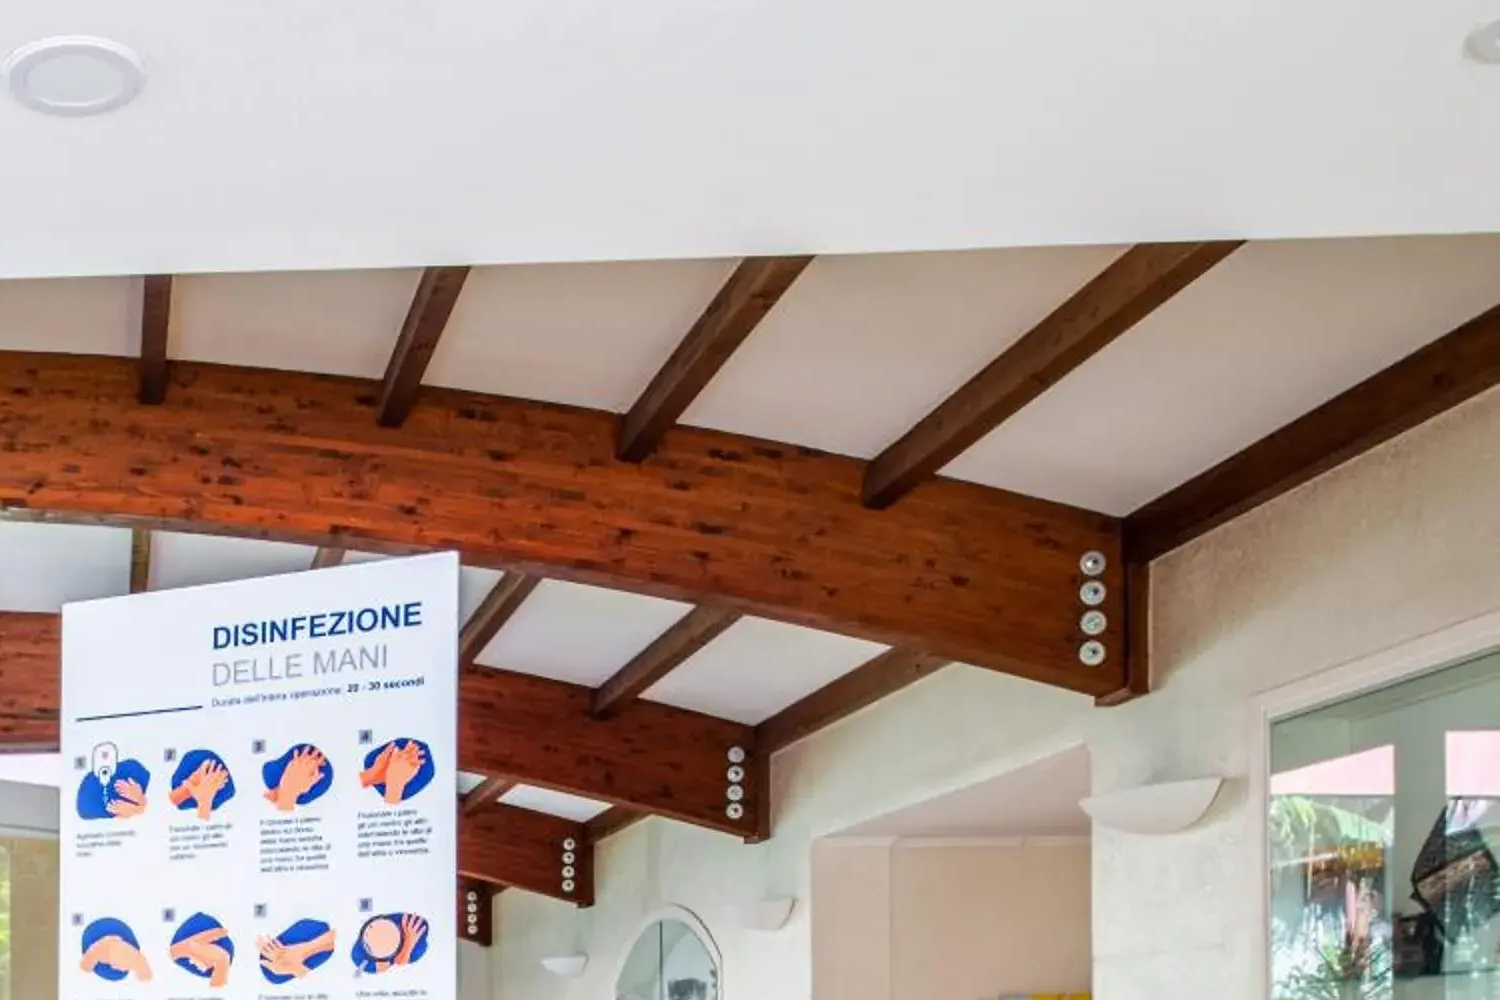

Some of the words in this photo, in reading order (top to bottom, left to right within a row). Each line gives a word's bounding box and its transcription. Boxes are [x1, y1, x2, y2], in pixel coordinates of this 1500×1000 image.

[212, 601, 423, 650] DISINFEZIONE
[212, 653, 303, 686] DELLE
[313, 643, 388, 675] MANI
[368, 680, 381, 691] 30
[383, 674, 425, 690] secondi
